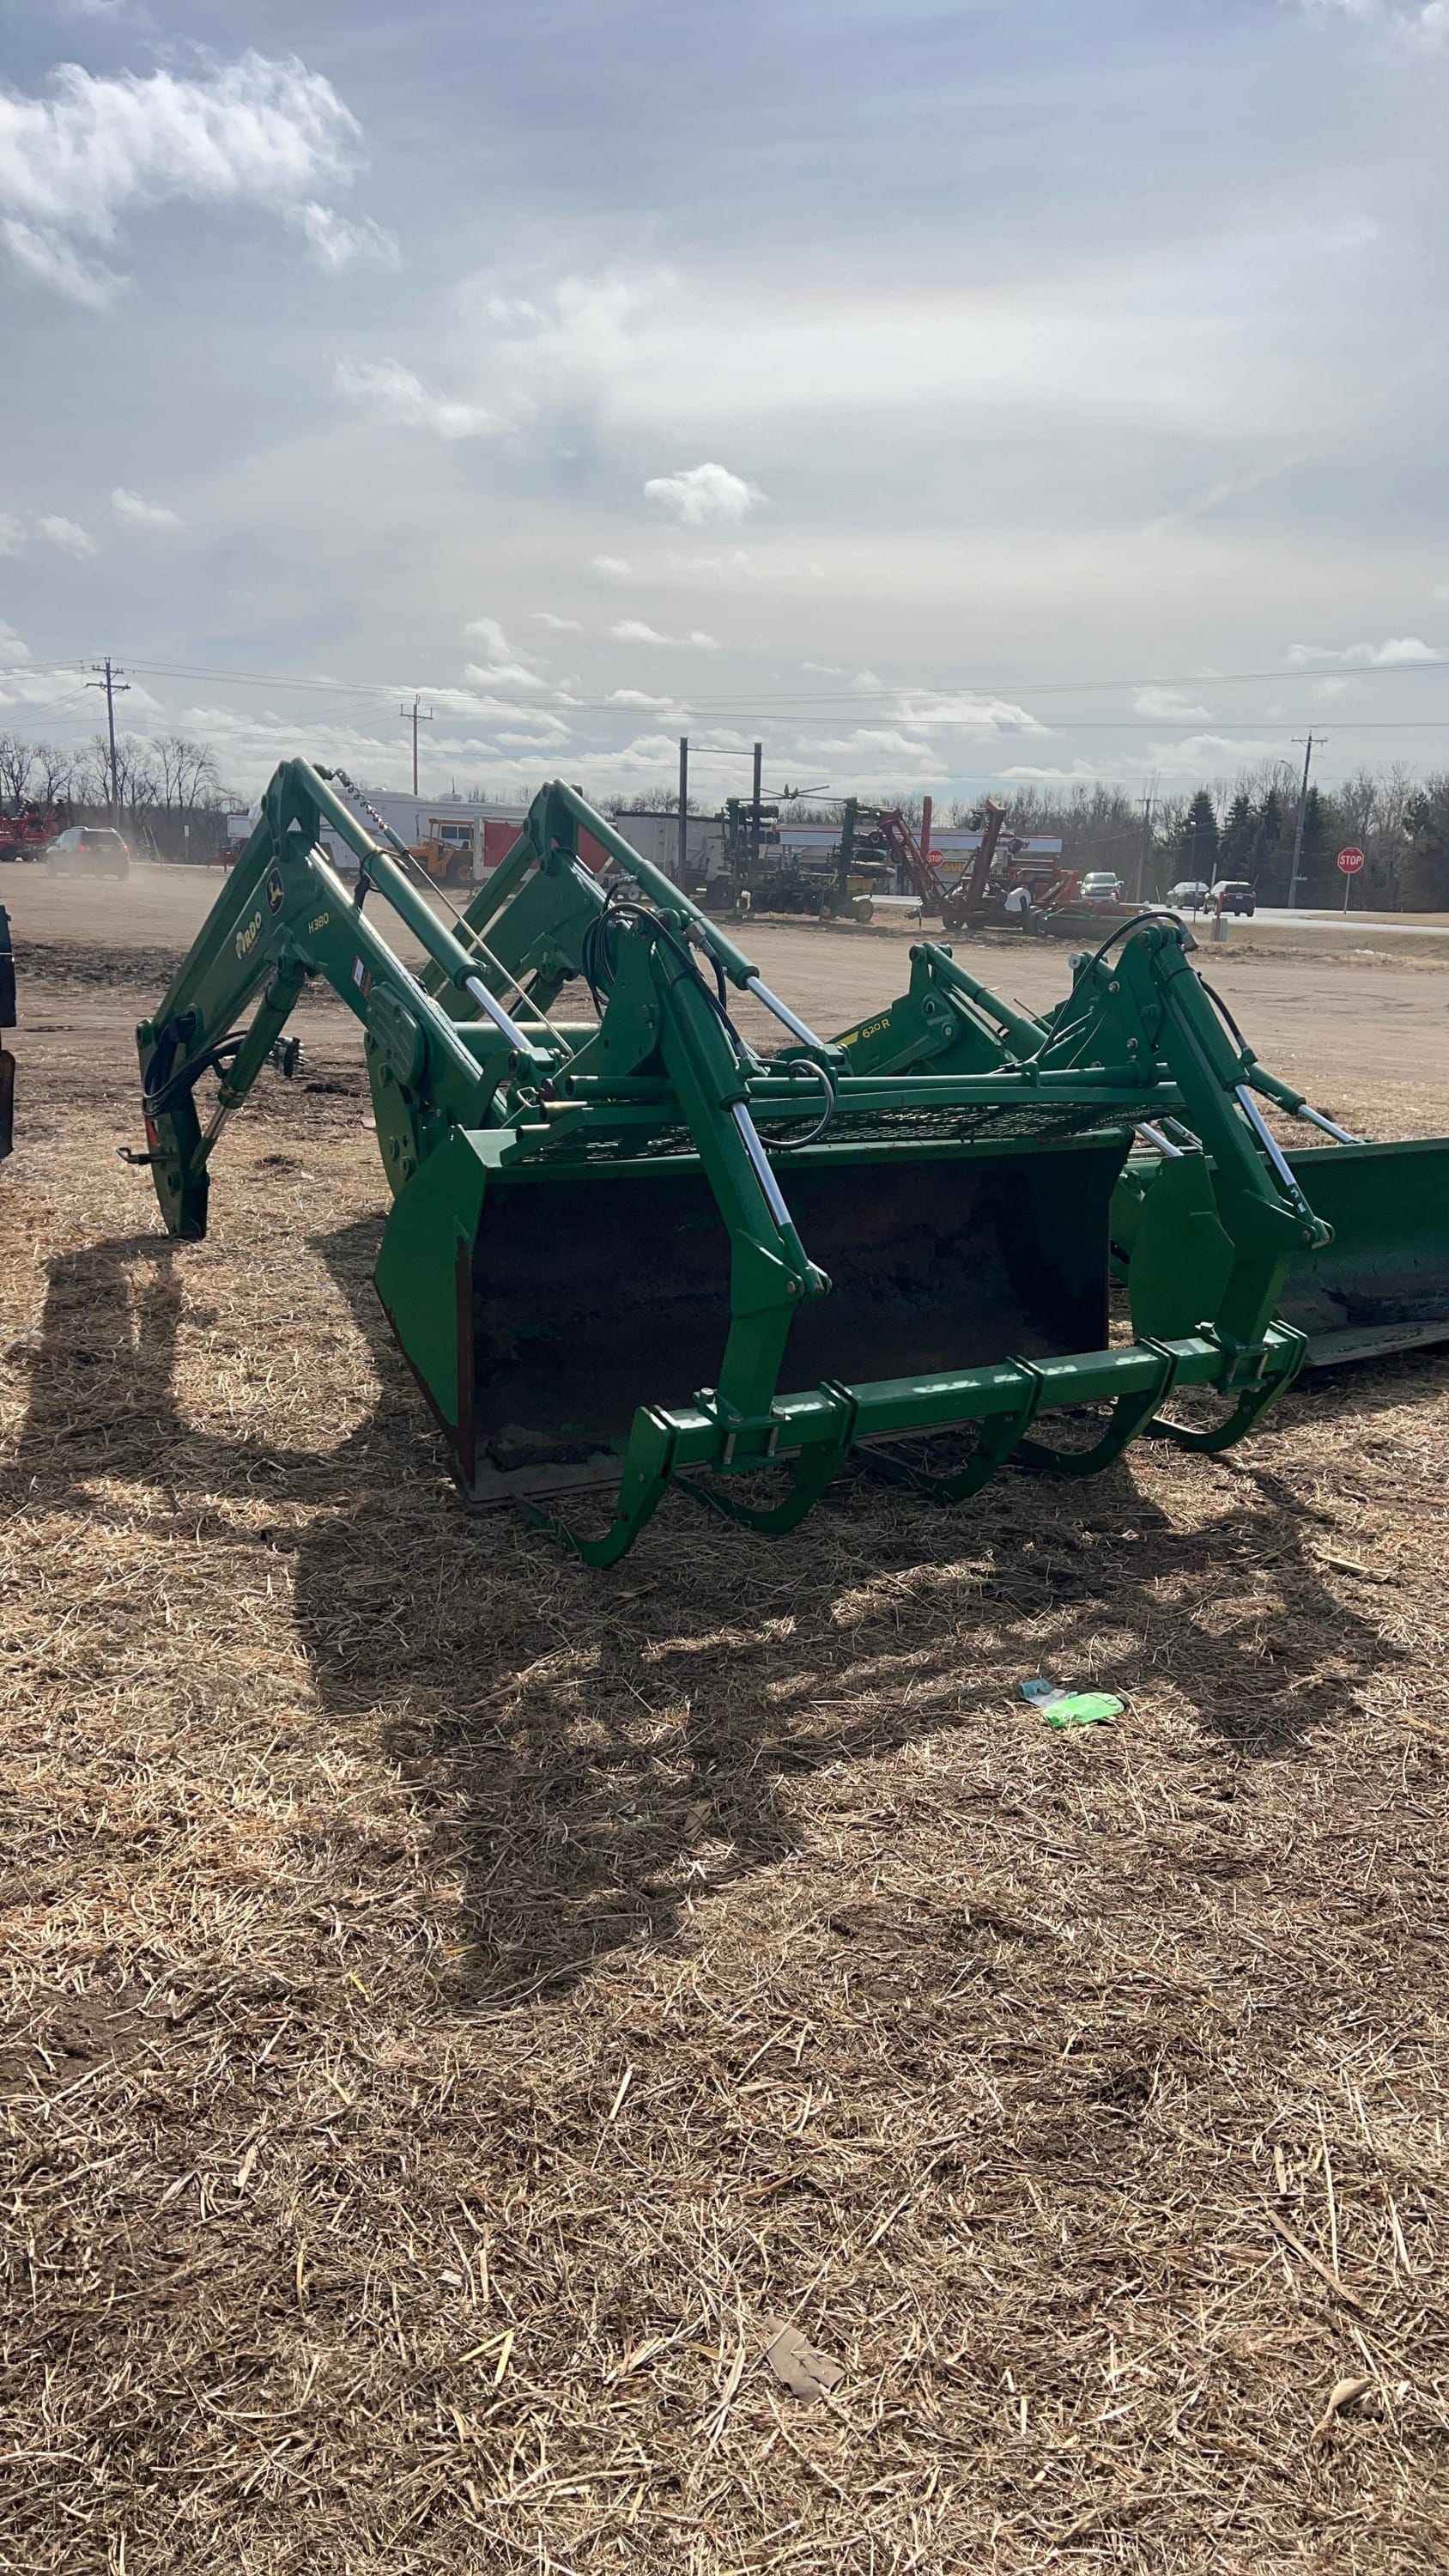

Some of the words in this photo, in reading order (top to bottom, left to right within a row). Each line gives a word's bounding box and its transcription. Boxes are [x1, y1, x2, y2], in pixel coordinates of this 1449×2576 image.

[928, 854, 943, 863] STOP
[1339, 855, 1362, 866] STOP
[308, 912, 330, 934] H380
